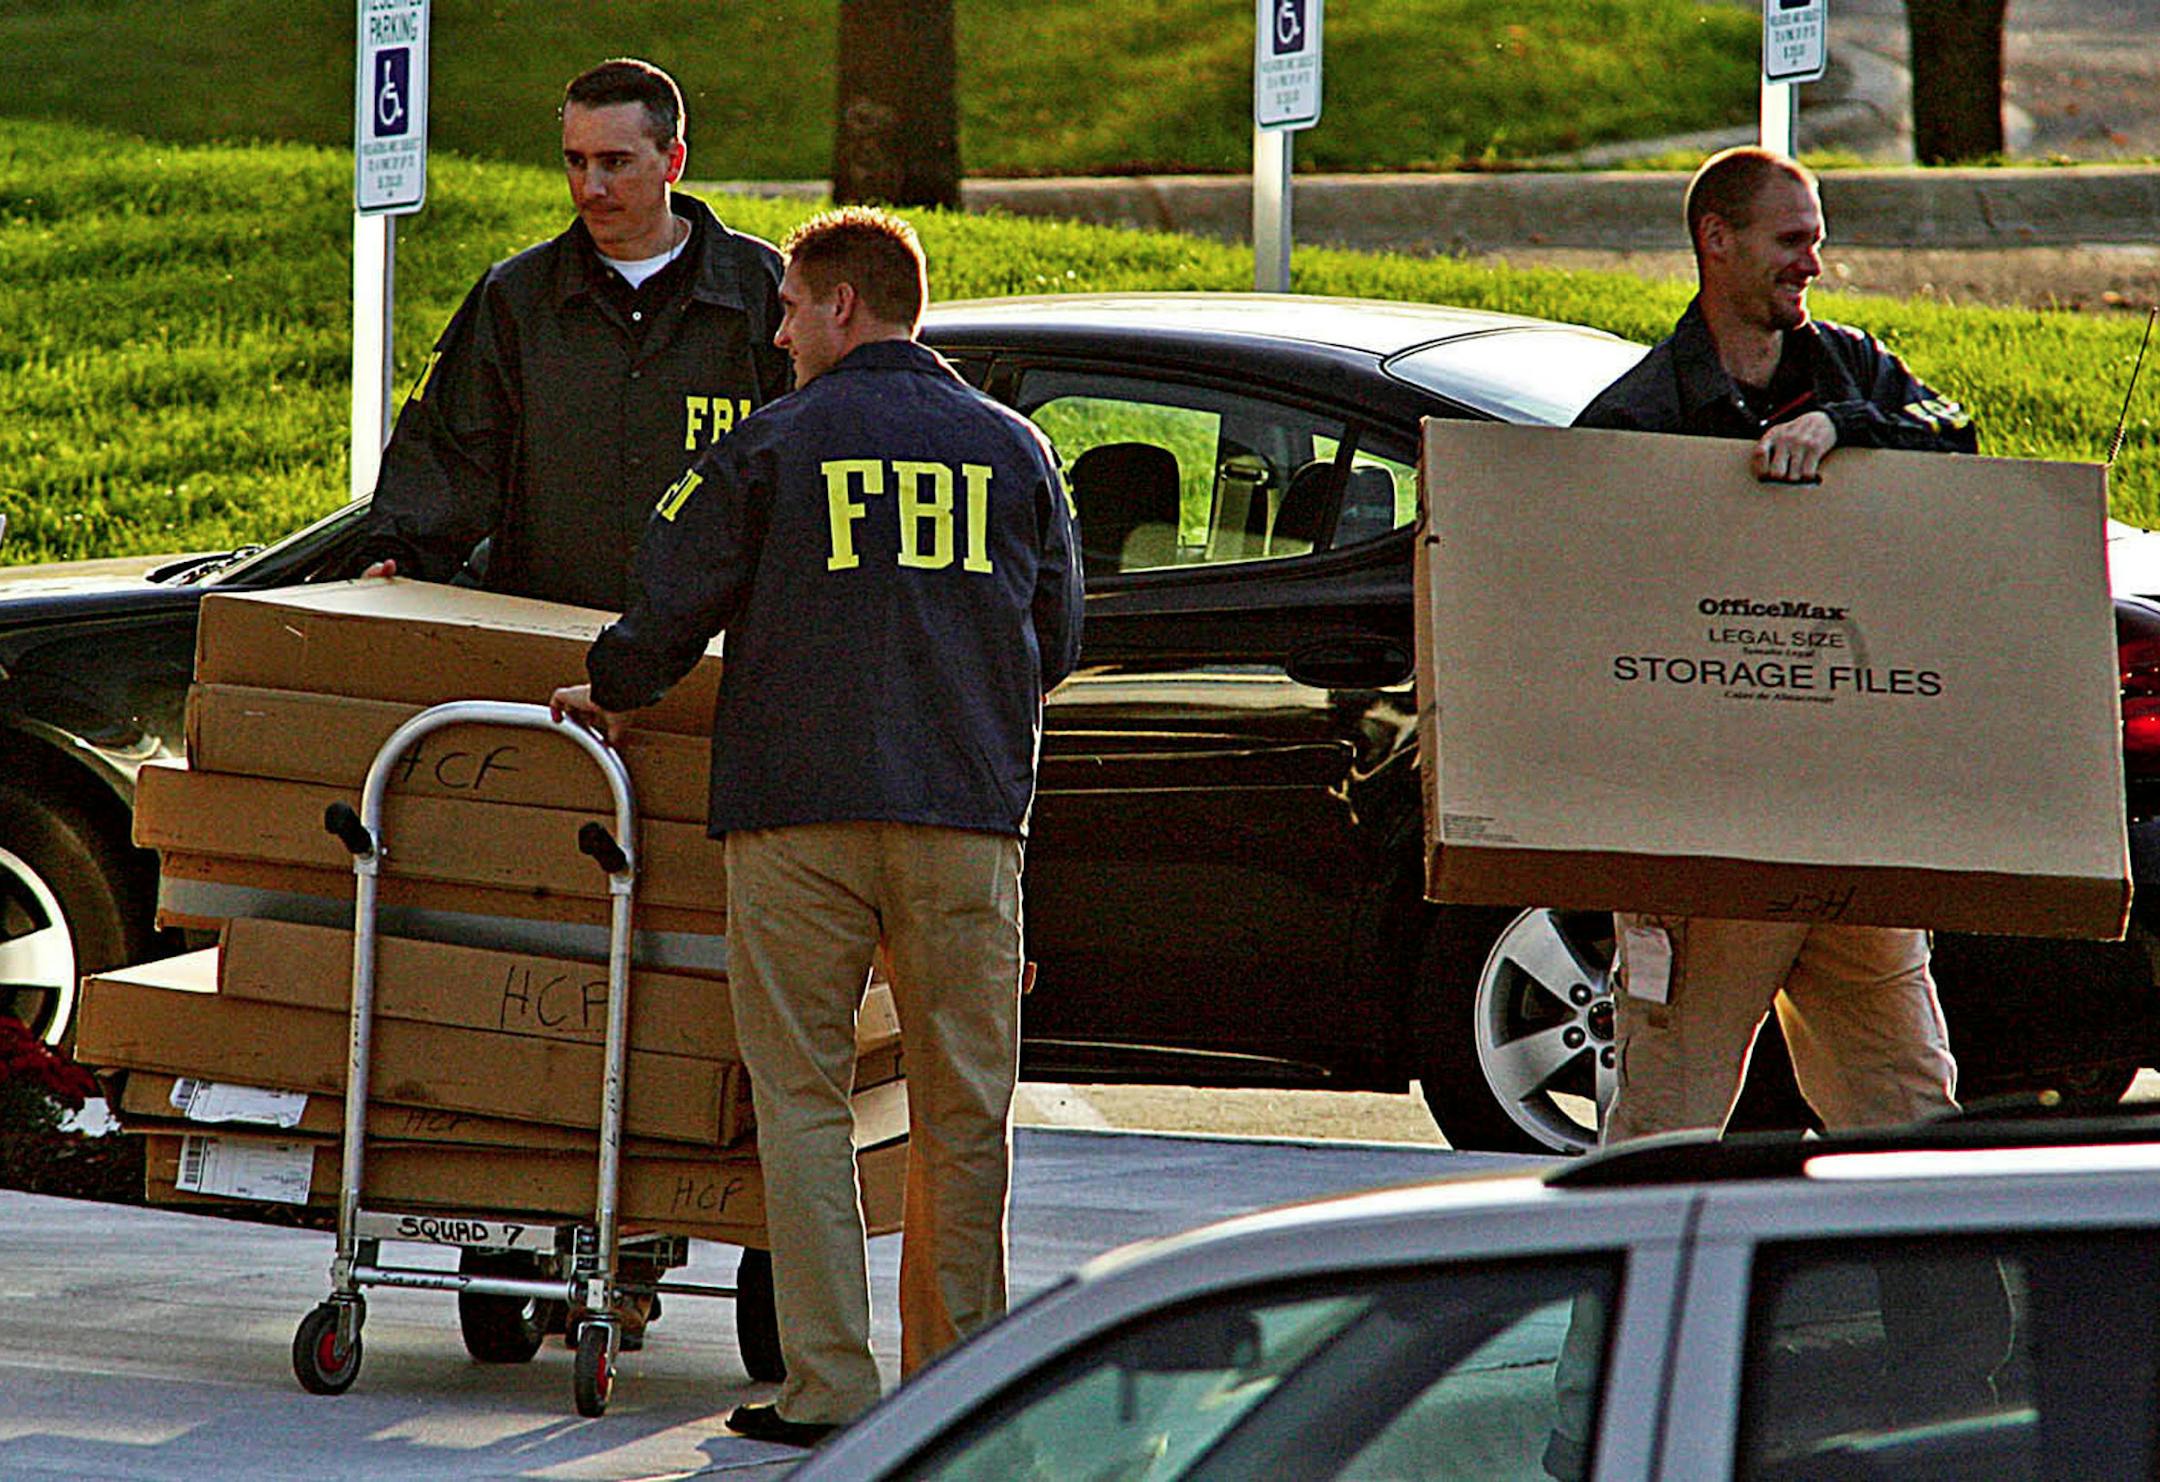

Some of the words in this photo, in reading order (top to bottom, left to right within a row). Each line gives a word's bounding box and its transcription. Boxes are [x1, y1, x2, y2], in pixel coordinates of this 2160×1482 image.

[370, 12, 418, 46] PARKING
[821, 459, 993, 574] FBI
[1699, 598, 1848, 621] OfficeMax
[1709, 628, 1786, 646] LEGAL
[1792, 631, 1845, 648] SIZE
[1614, 656, 1814, 690] STORAGE
[1830, 666, 1942, 696] FILES
[671, 1176, 745, 1212] HCF
[397, 1217, 489, 1243] SQUAD
[503, 1225, 525, 1246] 7
